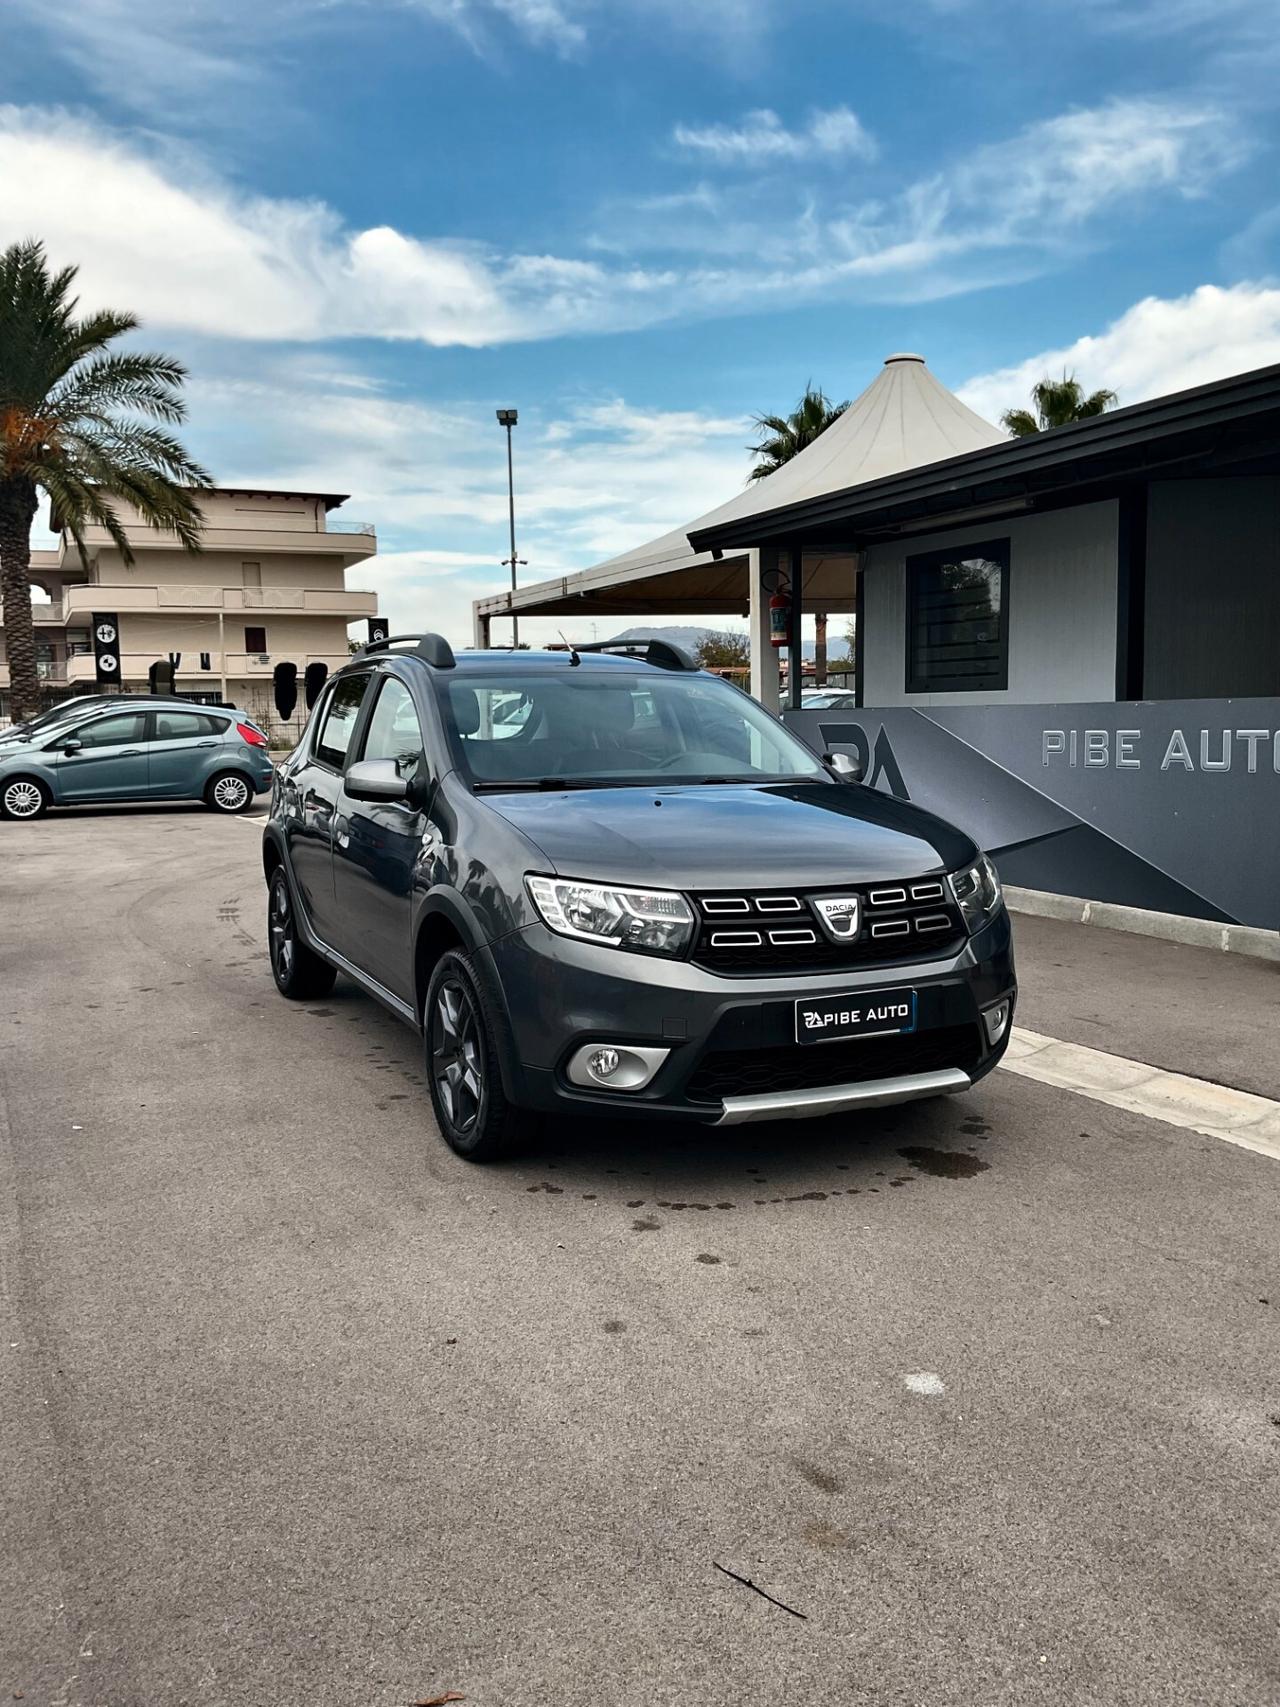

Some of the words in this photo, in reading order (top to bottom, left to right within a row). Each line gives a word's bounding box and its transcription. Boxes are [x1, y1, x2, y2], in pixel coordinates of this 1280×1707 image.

[1042, 729, 1141, 769] PIBE
[1160, 729, 1280, 774] AUT
[825, 904, 855, 912] DACIA
[824, 1010, 861, 1026] PIBE
[866, 1004, 909, 1021] AUTO
